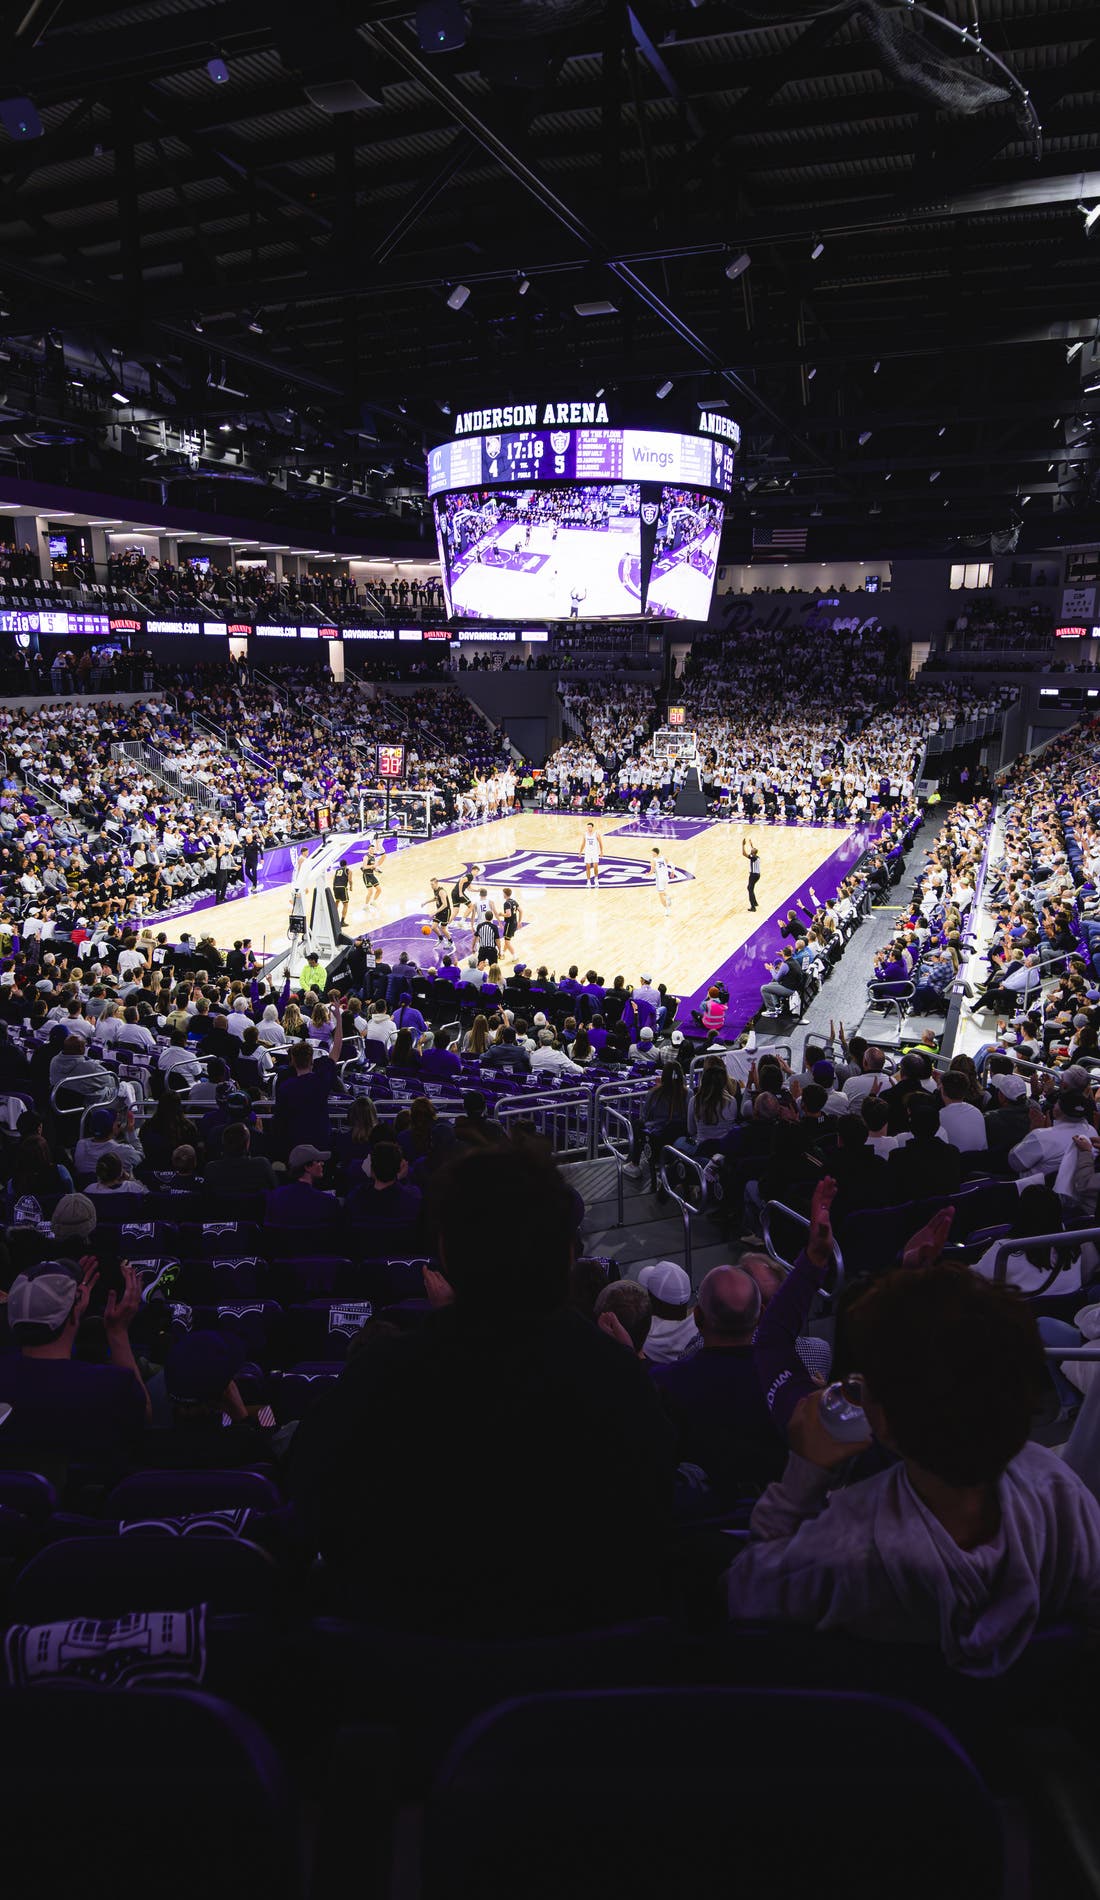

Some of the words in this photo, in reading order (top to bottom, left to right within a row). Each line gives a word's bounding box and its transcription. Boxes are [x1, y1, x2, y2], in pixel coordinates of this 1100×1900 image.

[454, 404, 537, 434] ANDERSON
[542, 402, 609, 424] ARENA
[507, 440, 544, 460] 17:18
[632, 447, 674, 467] Wings
[488, 459, 499, 478] 4
[554, 455, 565, 474] 5
[1, 616, 29, 631] 17:18
[458, 631, 516, 641] DAVANNIS.COM
[480, 904, 487, 912] 12
